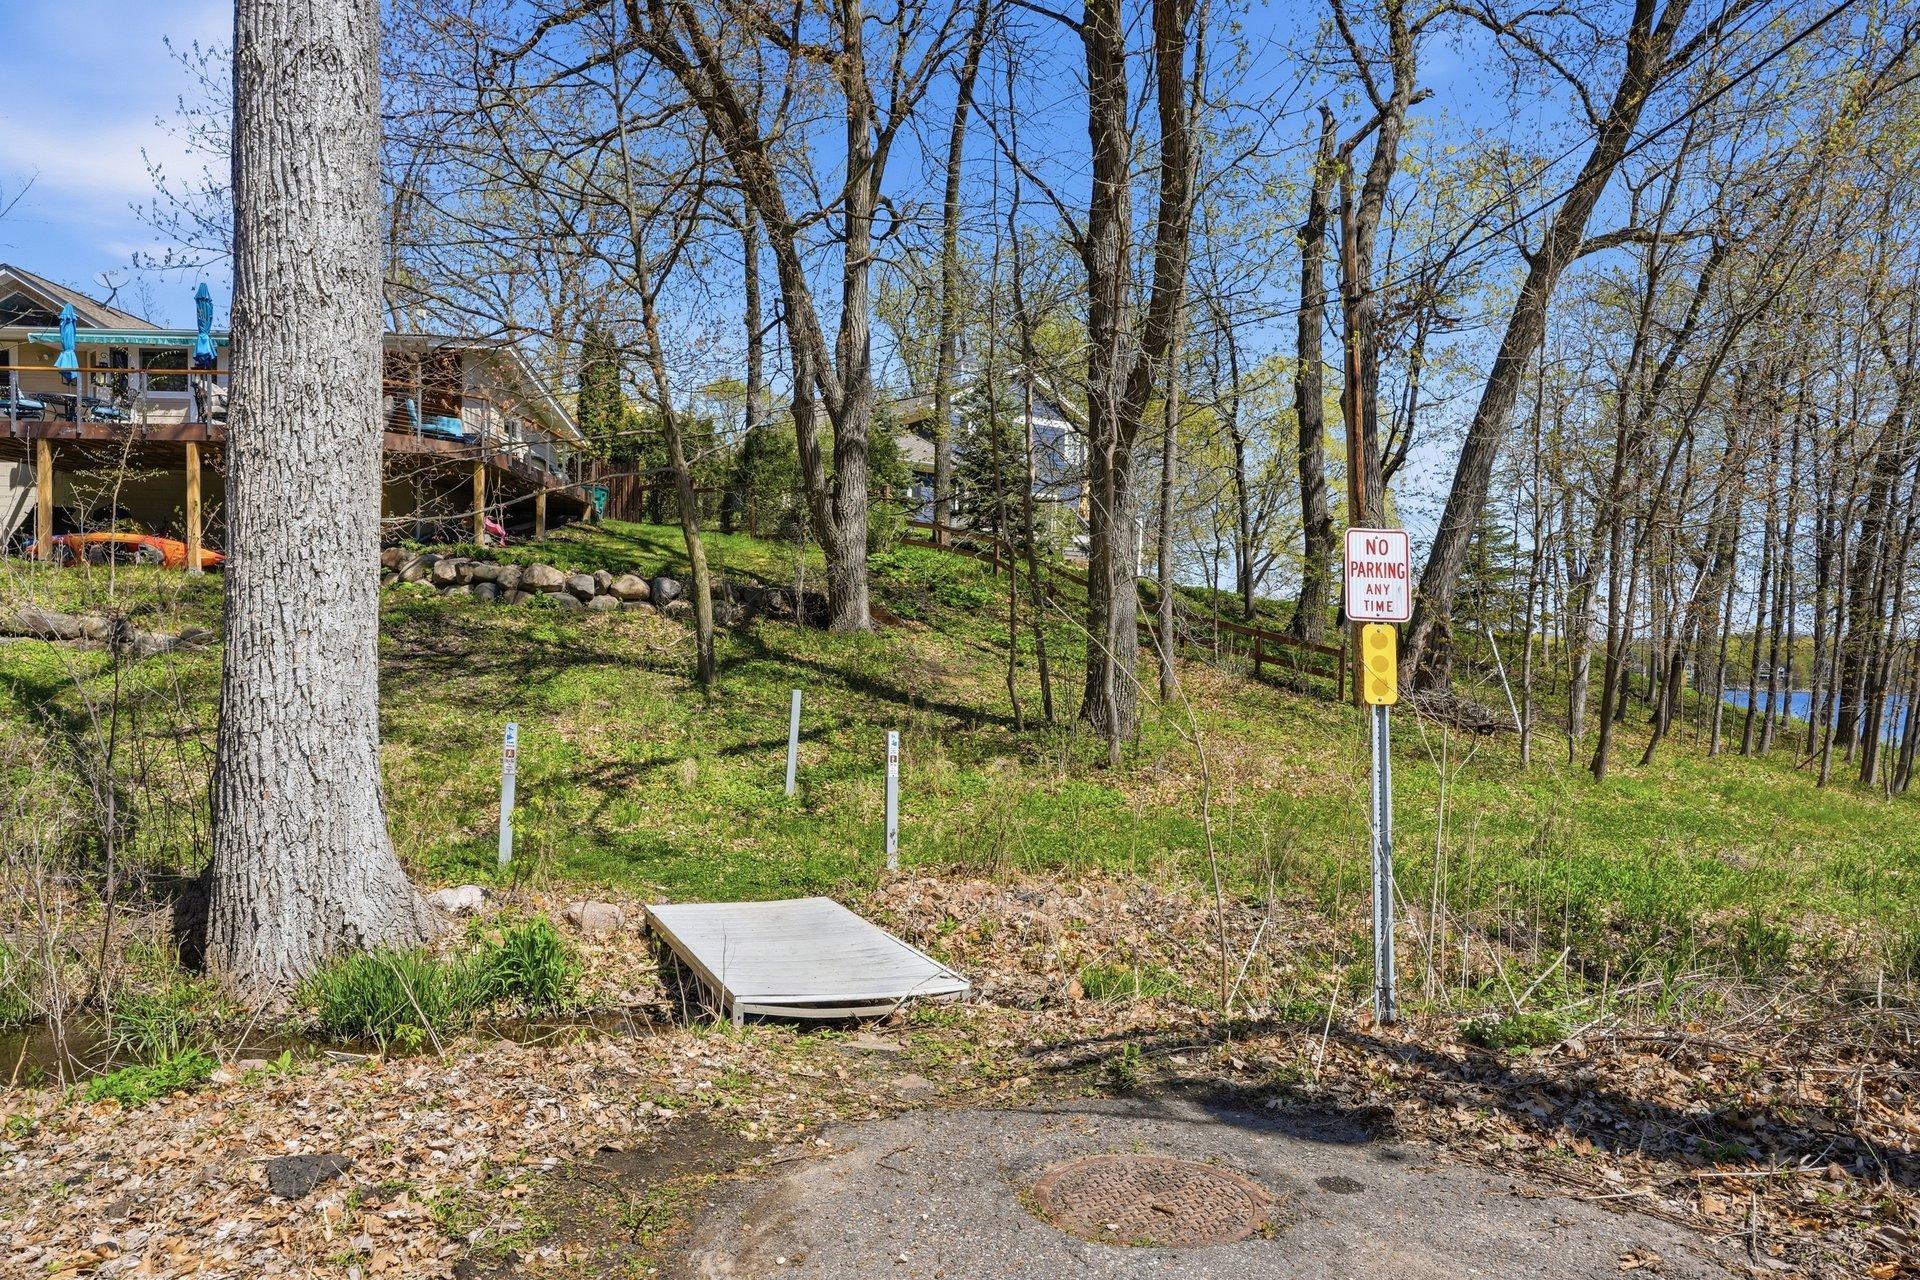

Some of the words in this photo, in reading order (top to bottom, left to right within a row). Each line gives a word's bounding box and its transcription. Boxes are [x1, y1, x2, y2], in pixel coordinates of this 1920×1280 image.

[1366, 539, 1388, 555] NO
[1350, 561, 1405, 579] PARKING
[1366, 584, 1390, 595] ANY
[1363, 600, 1393, 612] TIME
